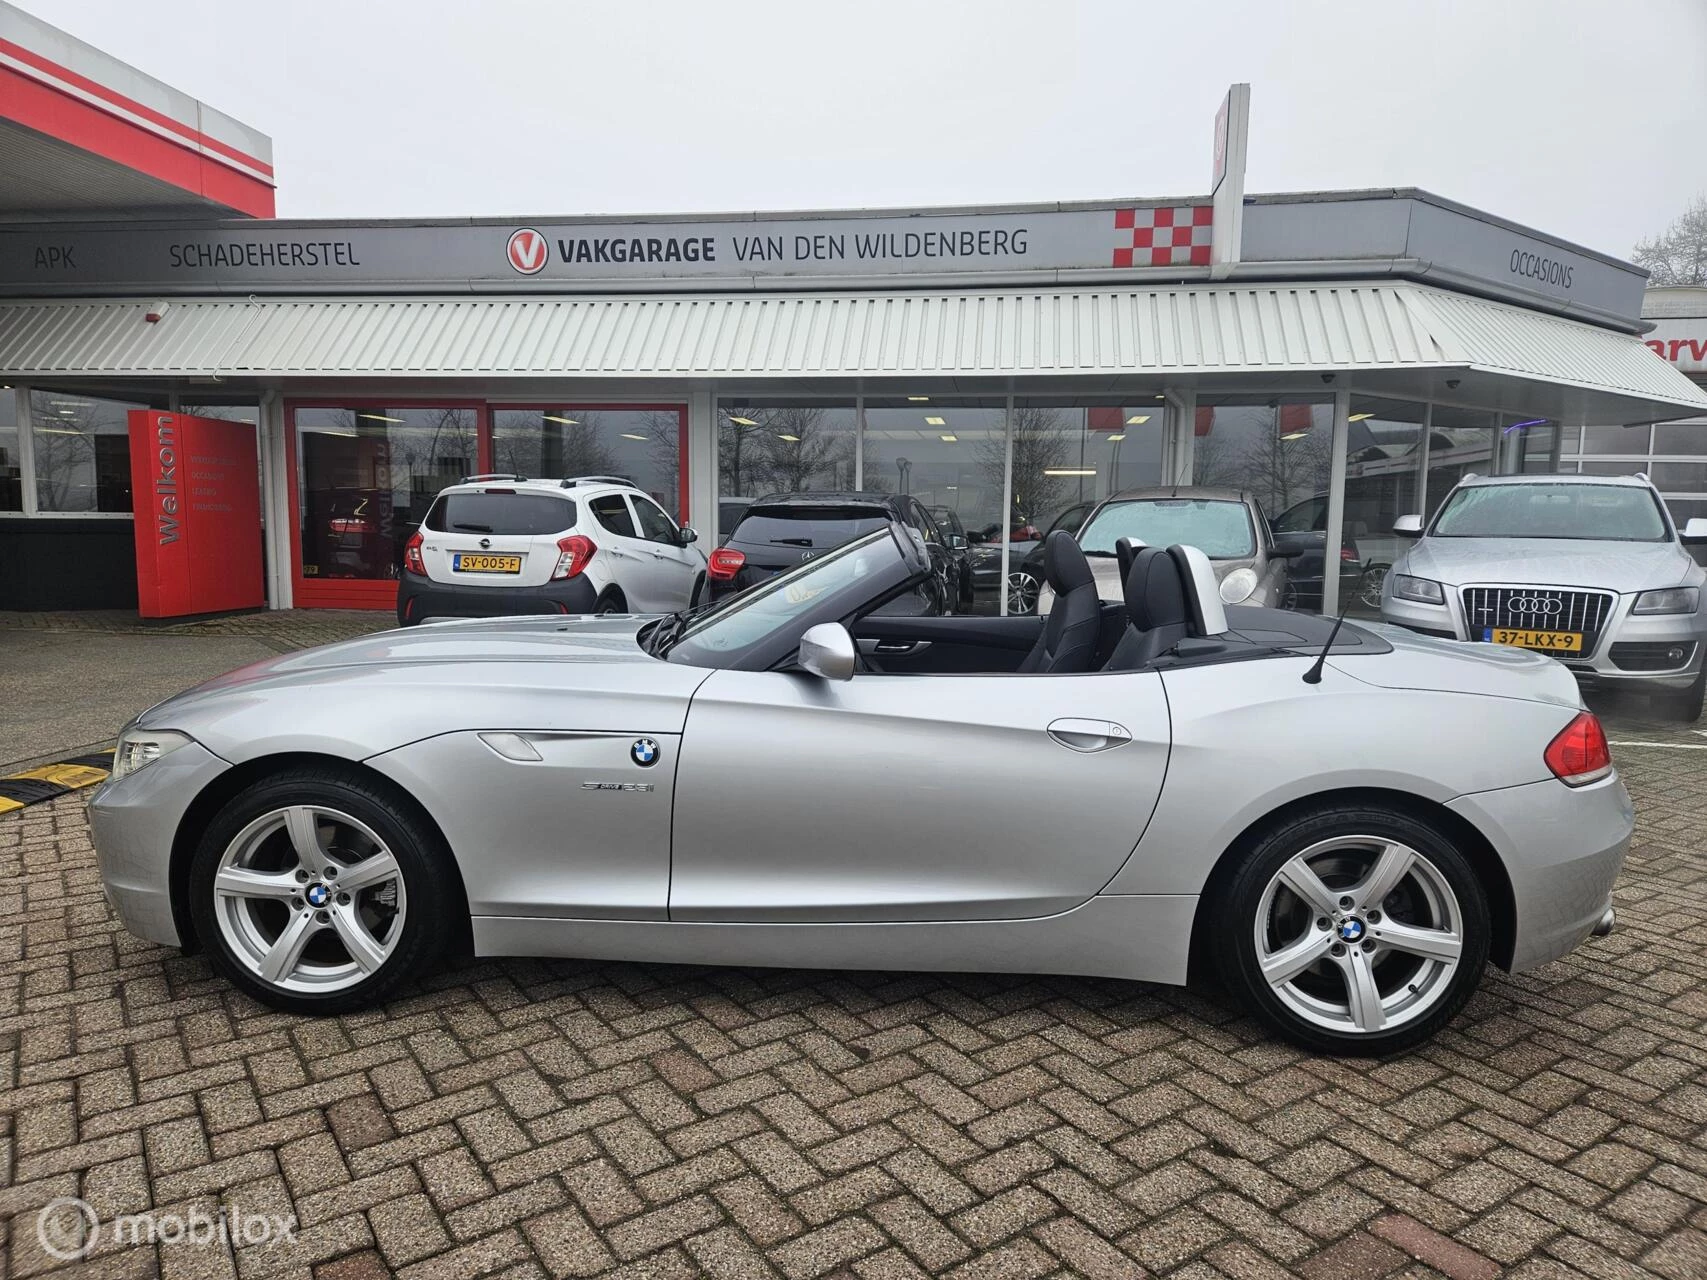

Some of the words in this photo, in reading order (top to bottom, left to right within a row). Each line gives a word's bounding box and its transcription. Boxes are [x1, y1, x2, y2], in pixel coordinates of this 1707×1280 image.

[34, 246, 77, 269] APK
[169, 242, 361, 268] SCHADEHERSTEL
[557, 237, 716, 263] VAKGARAGE
[732, 236, 783, 261] VAN
[794, 234, 846, 260] DEN
[854, 228, 1029, 259] WILDENBERG
[1510, 249, 1574, 289] OCCASIONS
[157, 416, 179, 545] Welkom
[463, 556, 516, 569] SV-005-F
[1498, 631, 1574, 648] 37-LKX-9
